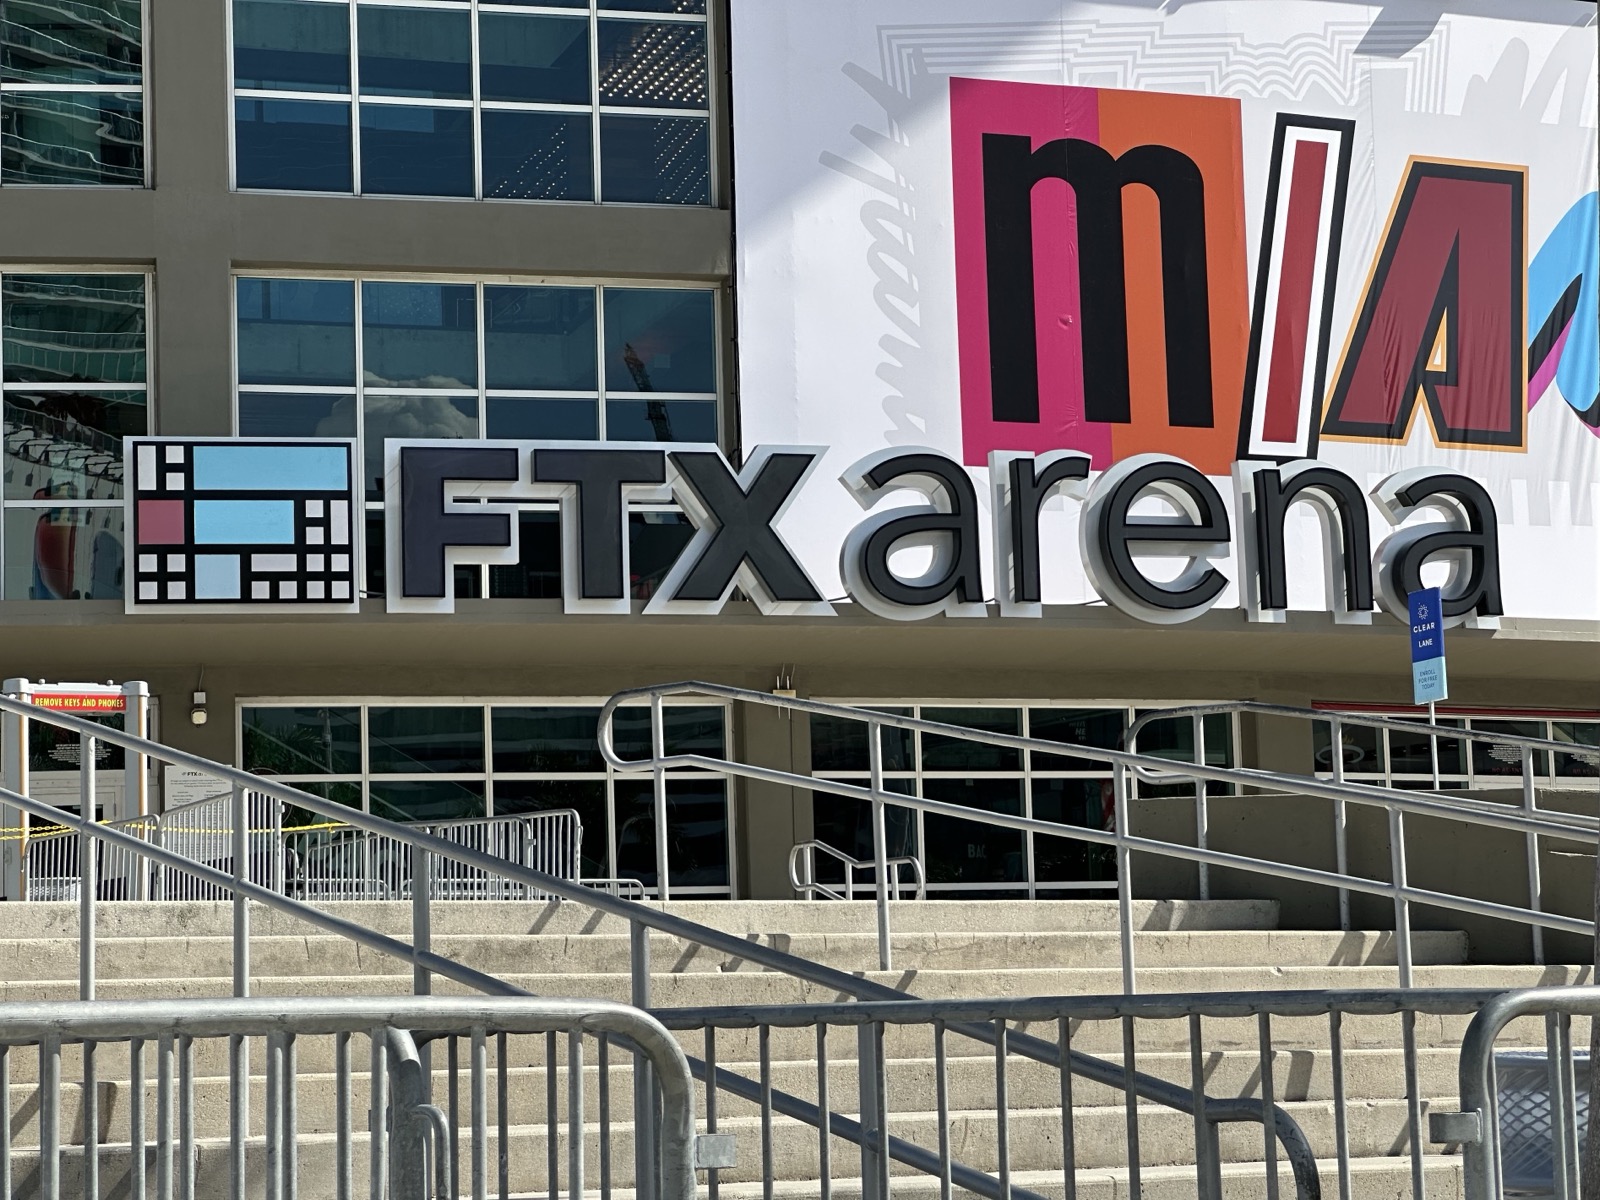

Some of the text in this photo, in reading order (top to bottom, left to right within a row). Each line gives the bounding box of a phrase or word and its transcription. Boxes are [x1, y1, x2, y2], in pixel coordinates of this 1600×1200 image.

[384, 437, 1504, 624] FTX arena
[1413, 622, 1435, 633] CLEAR
[1418, 638, 1433, 648] LANE
[1419, 669, 1436, 677] ENROLL
[1418, 675, 1438, 684] FOR FREE
[1421, 682, 1435, 690] TODAY
[35, 697, 124, 708] REMOVE KEYS AND PHONES
